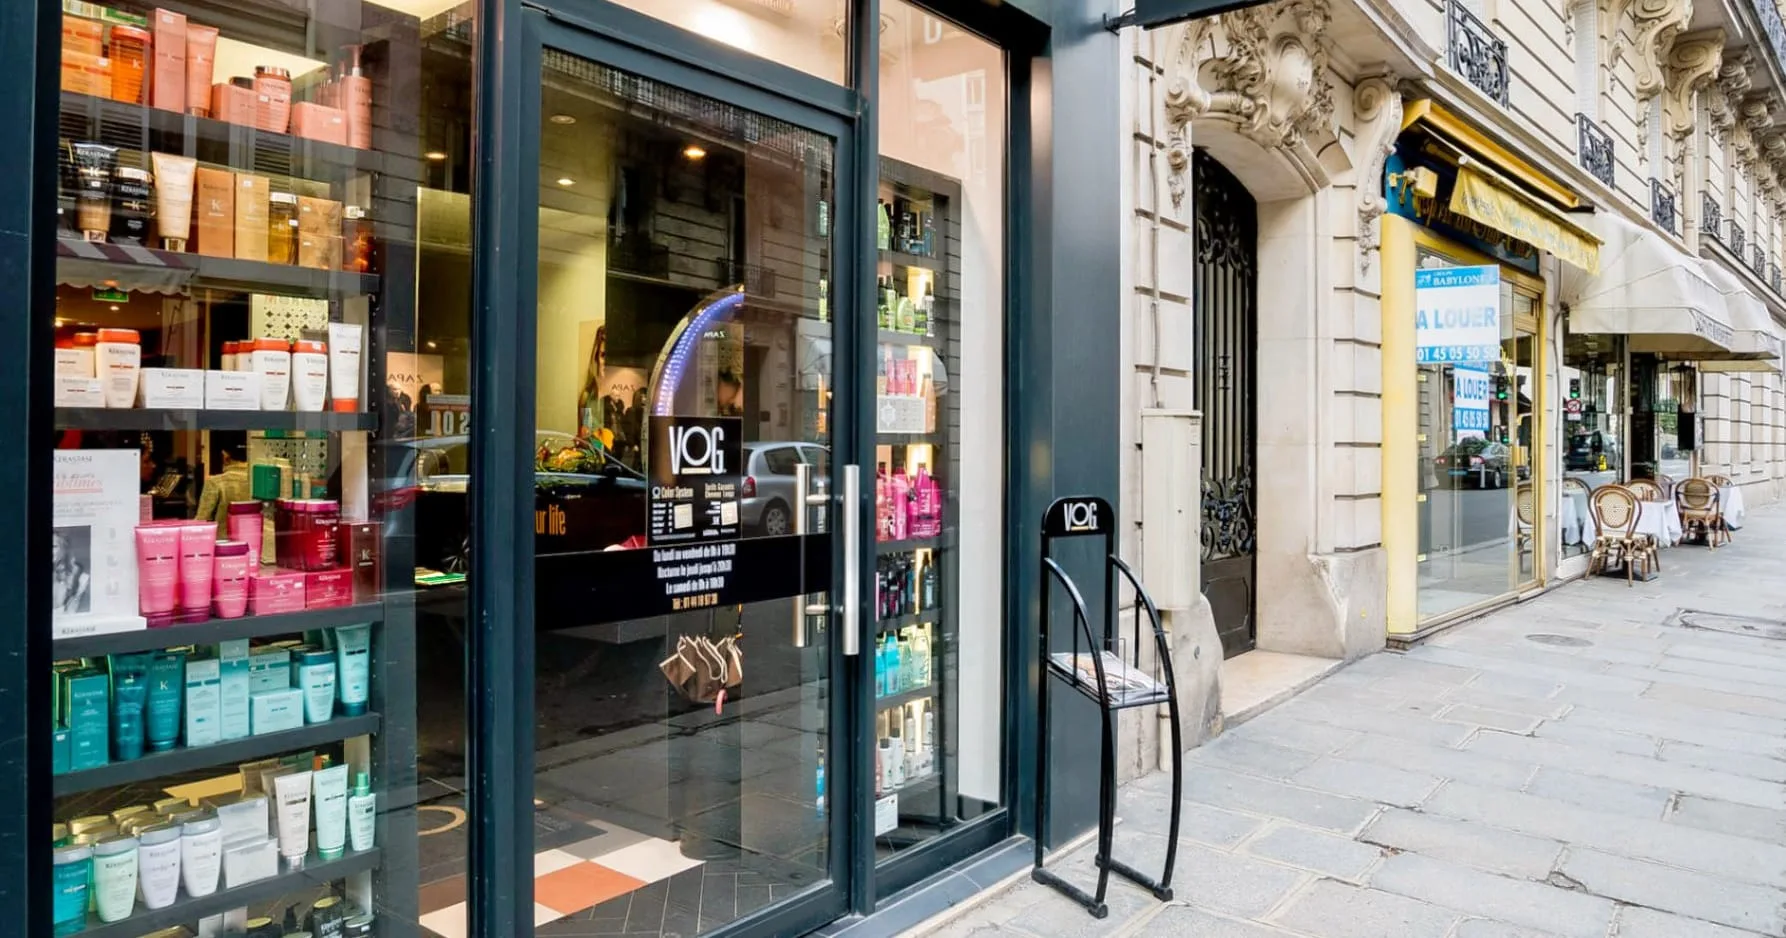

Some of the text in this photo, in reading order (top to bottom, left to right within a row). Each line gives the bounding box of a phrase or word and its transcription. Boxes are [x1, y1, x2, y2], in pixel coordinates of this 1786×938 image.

[1415, 307, 1497, 330] A LOUER
[1433, 347, 1446, 361] 45
[1450, 346, 1463, 360] 05
[1466, 345, 1480, 360] 50
[668, 426, 725, 475] VOG
[1063, 502, 1097, 531] VOG
